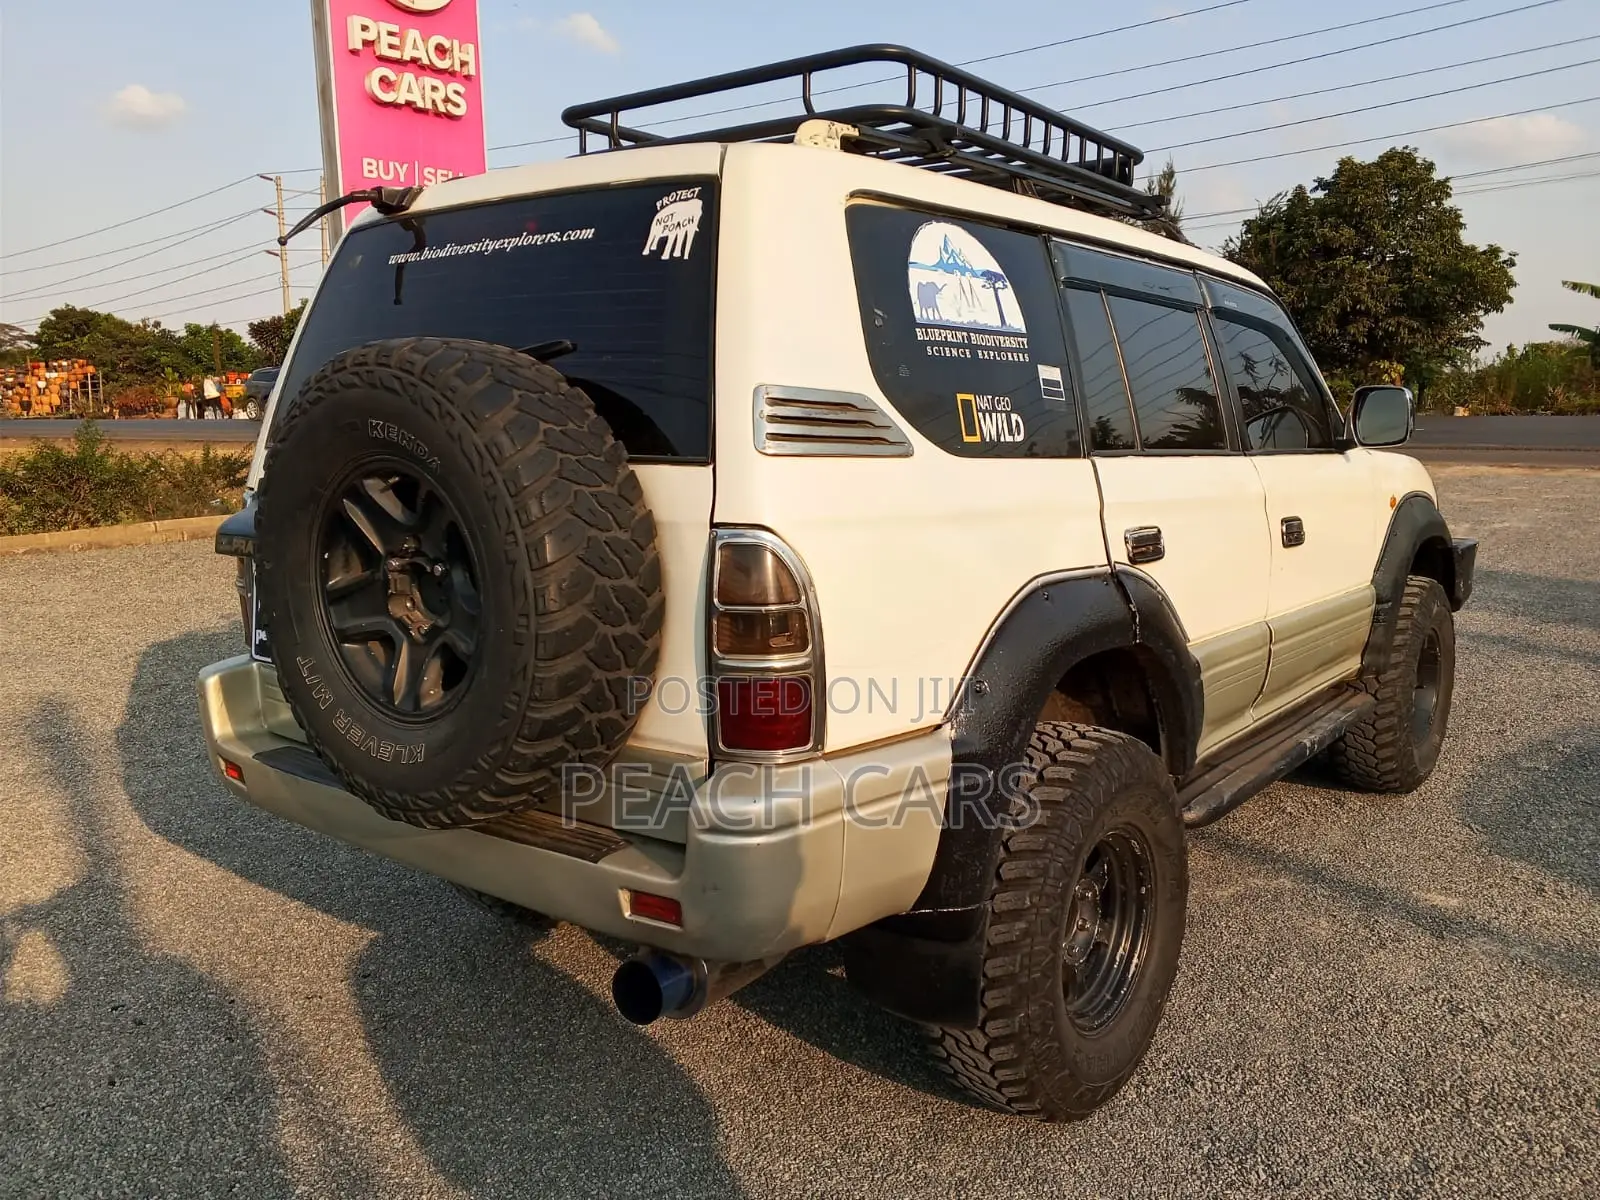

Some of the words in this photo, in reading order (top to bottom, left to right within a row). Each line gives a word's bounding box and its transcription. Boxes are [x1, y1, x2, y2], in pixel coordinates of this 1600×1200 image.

[347, 15, 476, 76] PEACH
[365, 66, 467, 116] CARS
[362, 157, 408, 182] BUY
[656, 187, 702, 211] PROTECT
[655, 212, 676, 226] NOT
[662, 216, 695, 233] POACH
[388, 227, 596, 265] www.biodiversityexplorers.com
[915, 328, 969, 344] BLUEPRINT
[969, 332, 1028, 349] BIODIVERSITY
[926, 345, 972, 358] SCIENCE
[977, 350, 1030, 362] EXPLORERS
[976, 394, 993, 410] NAT
[994, 396, 1011, 411] GEO
[978, 412, 1025, 442] WILD
[368, 418, 441, 476] KENDA
[332, 708, 425, 764] KLEVER
